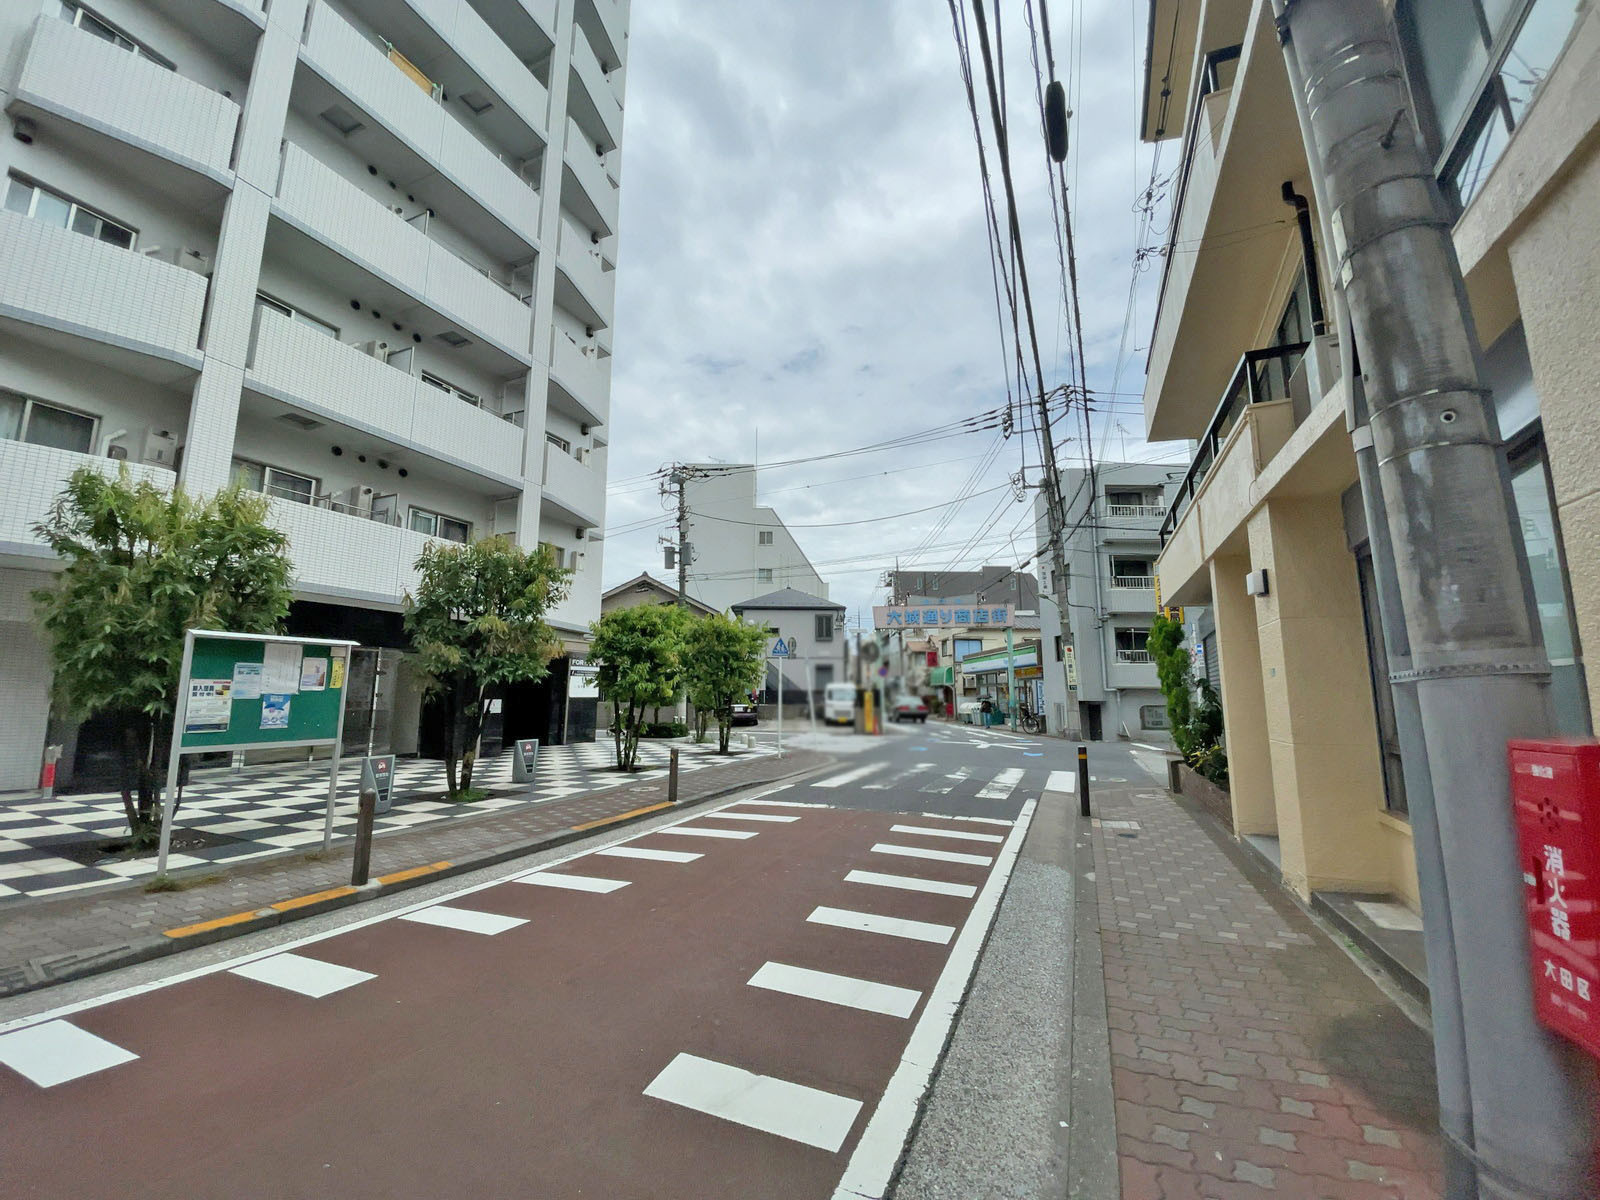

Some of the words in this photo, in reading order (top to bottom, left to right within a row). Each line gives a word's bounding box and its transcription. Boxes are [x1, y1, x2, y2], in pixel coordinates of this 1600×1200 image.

[886, 608, 1007, 625] 大城通り商店街
[1543, 844, 1571, 941] 消火器
[1543, 959, 1591, 1001] 大田区
